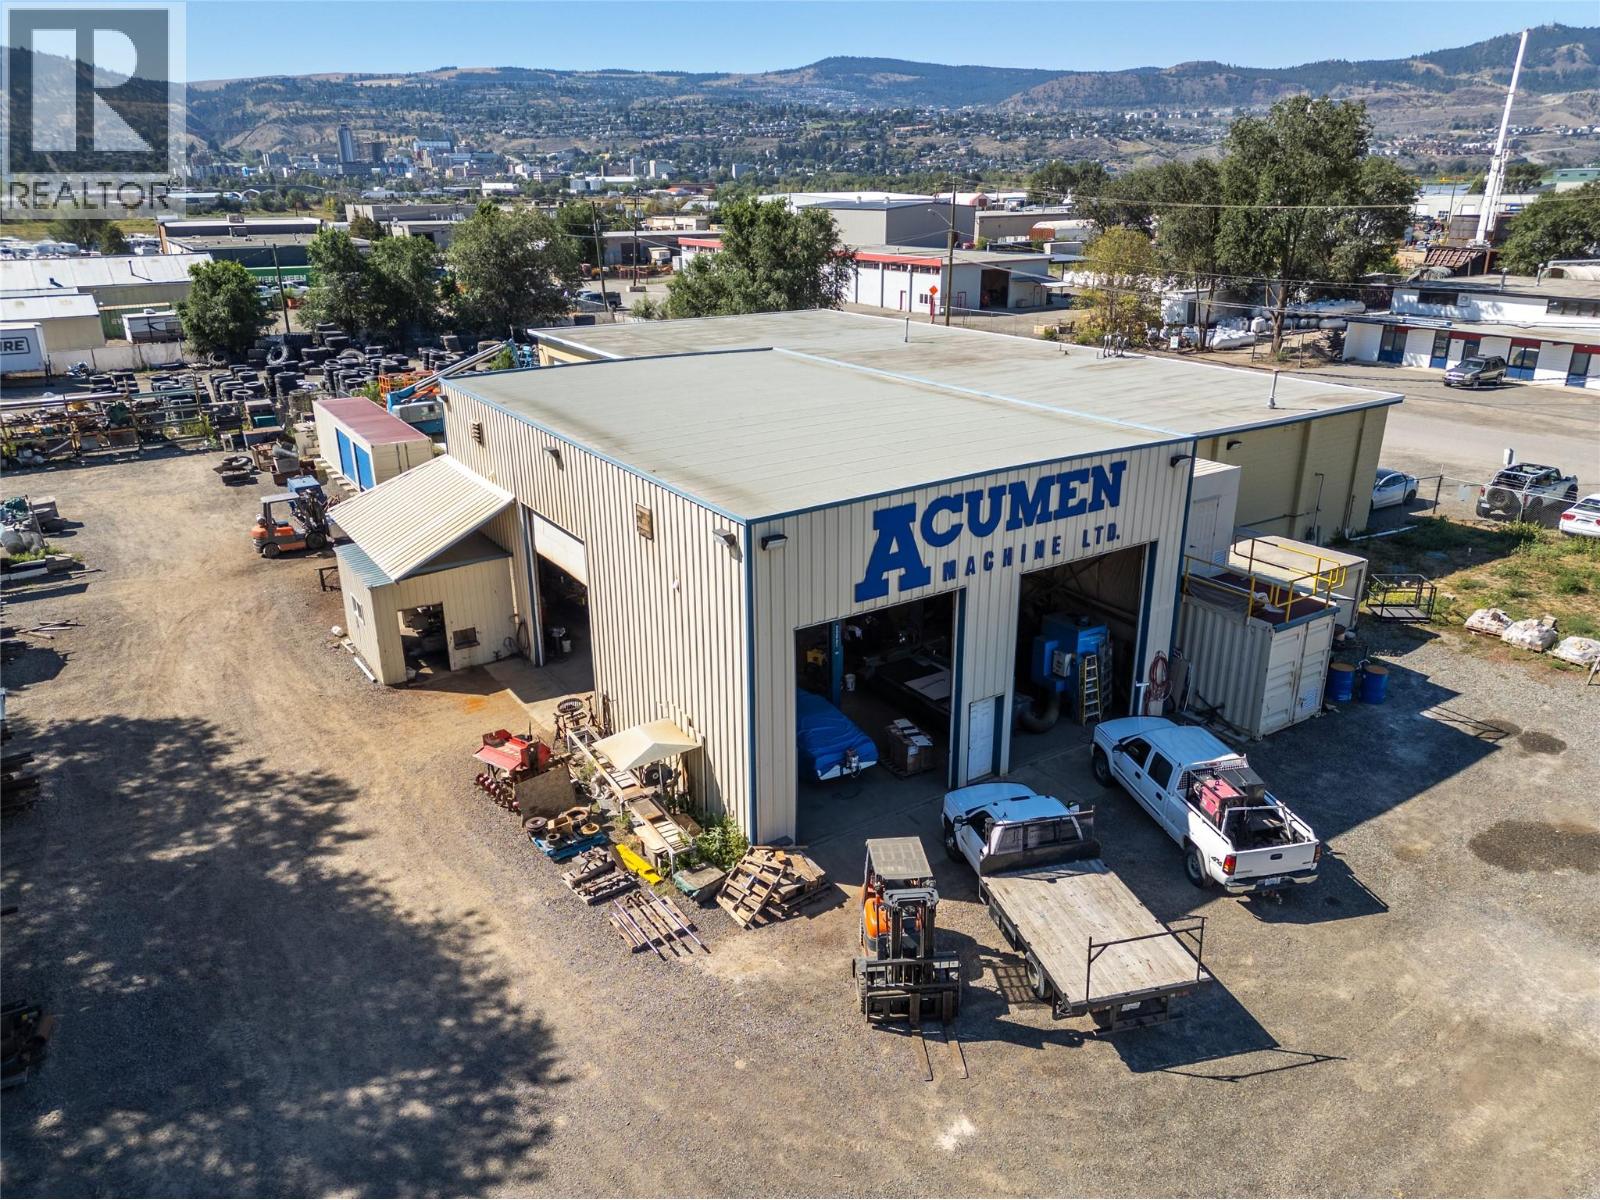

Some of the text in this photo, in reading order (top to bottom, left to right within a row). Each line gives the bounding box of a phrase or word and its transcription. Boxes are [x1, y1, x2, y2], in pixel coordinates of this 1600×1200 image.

[854, 460, 1127, 603] ACUMEN
[942, 522, 1120, 582] MACHINE LTD.
